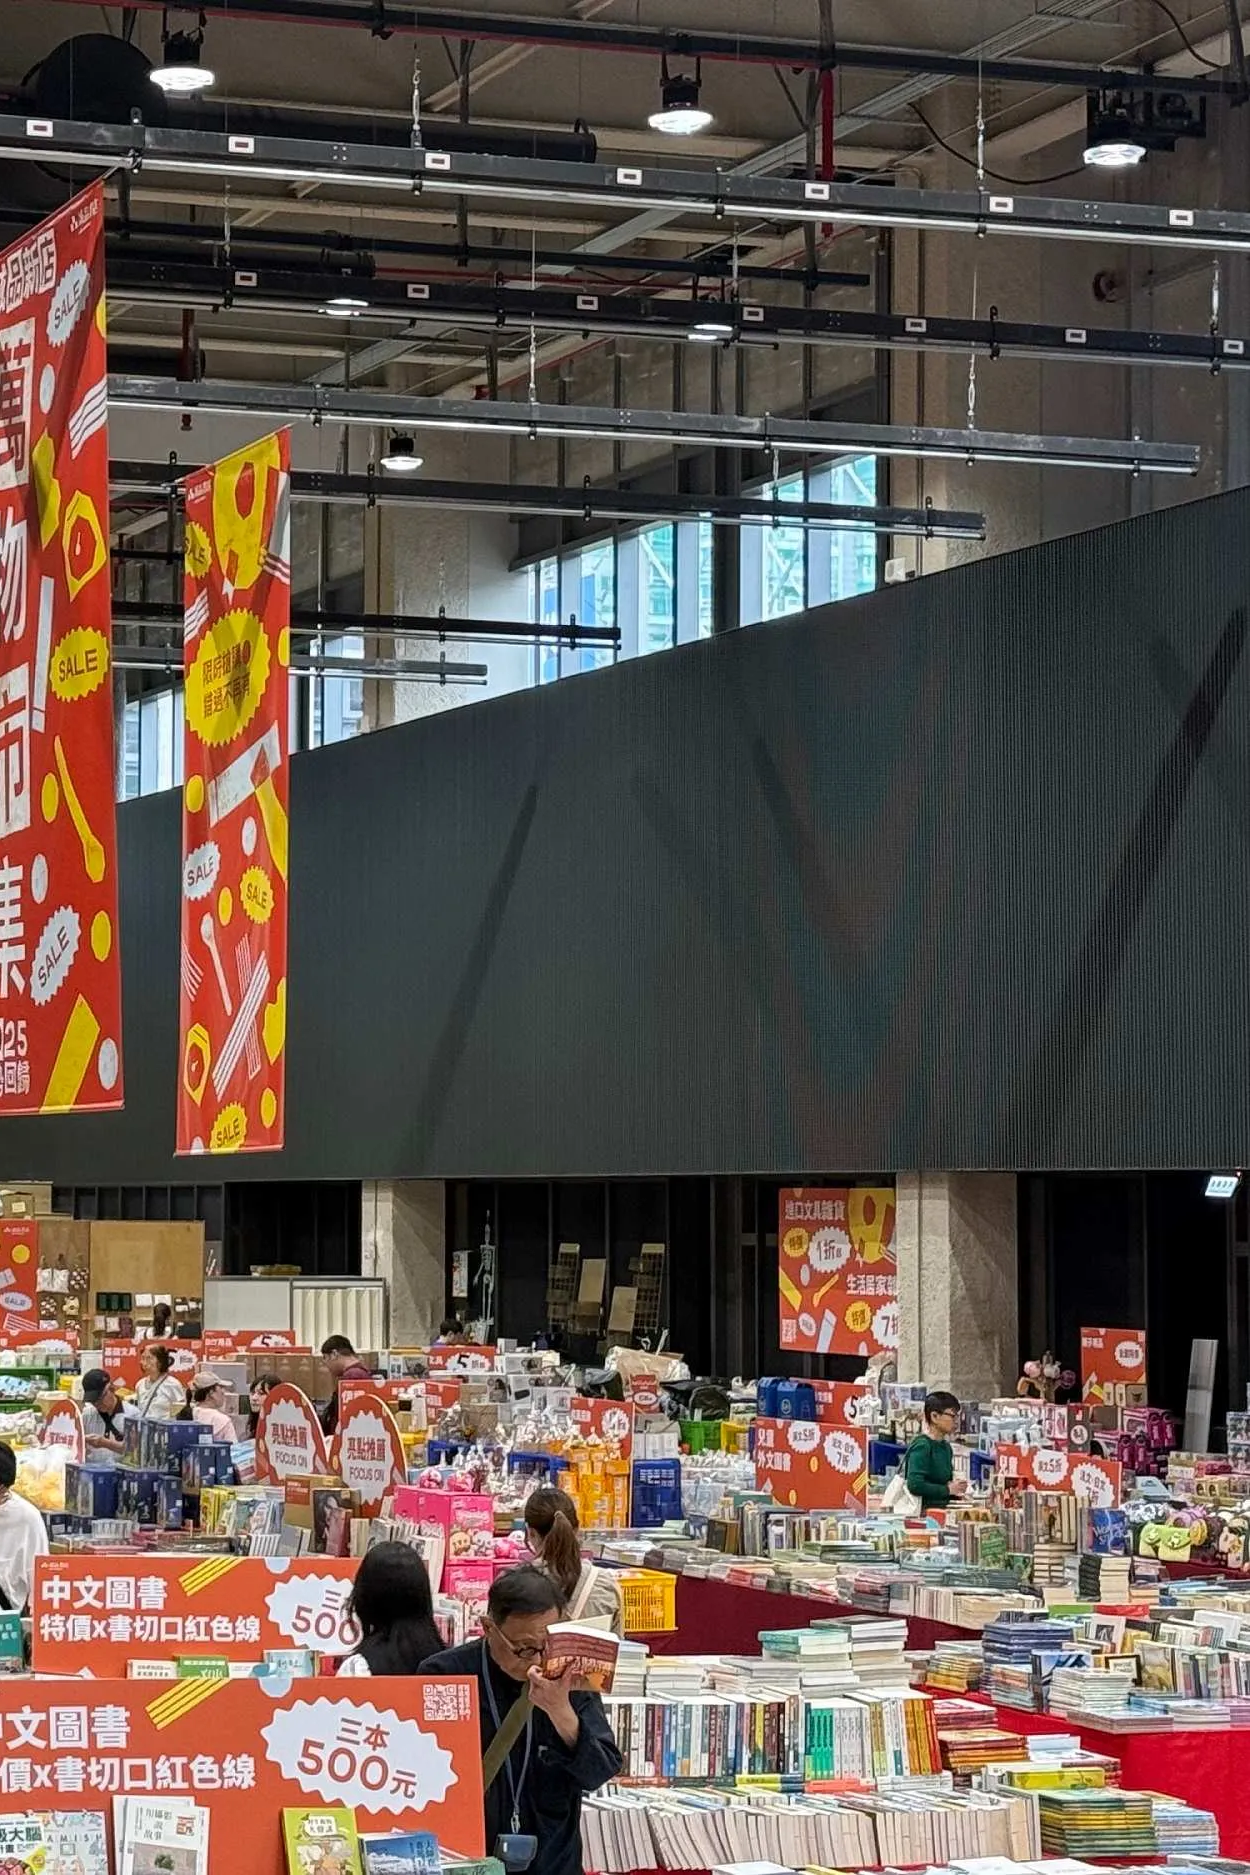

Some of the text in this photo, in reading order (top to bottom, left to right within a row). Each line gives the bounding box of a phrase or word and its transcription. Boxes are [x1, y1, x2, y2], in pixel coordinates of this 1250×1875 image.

[54, 280, 80, 329] SALE
[57, 650, 99, 685] SALE
[187, 855, 215, 888] SALE
[246, 884, 269, 911] SALE
[36, 926, 69, 988] SALE
[215, 1117, 242, 1147] SALE
[275, 1450, 308, 1468] FOCUS ON
[350, 1466, 385, 1483] FOCUS ON
[41, 1575, 168, 1610] 中文圖書
[39, 1614, 261, 1643] 特價x書切口紅色線
[291, 1604, 363, 1647] 500
[336, 1717, 391, 1752] 三本
[297, 1738, 418, 1800] 500元
